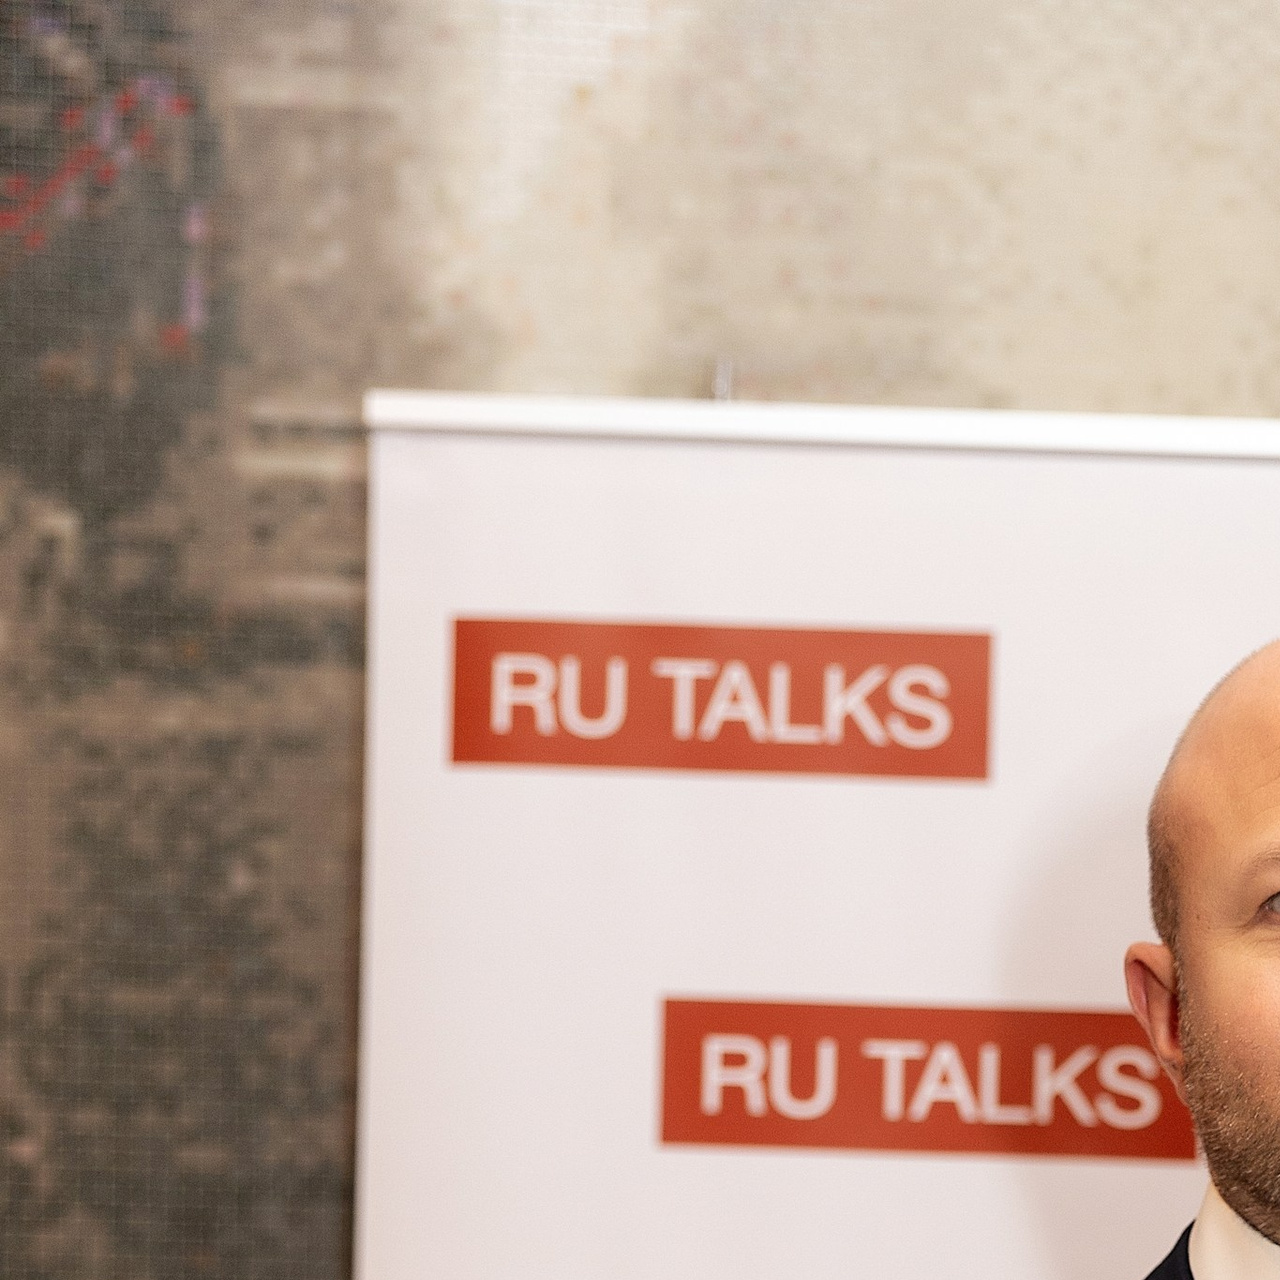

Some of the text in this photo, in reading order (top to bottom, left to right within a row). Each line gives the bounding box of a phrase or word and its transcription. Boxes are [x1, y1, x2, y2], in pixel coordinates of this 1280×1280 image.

[488, 650, 957, 752] RU TALKS
[698, 1031, 1163, 1131] RU TALKS
